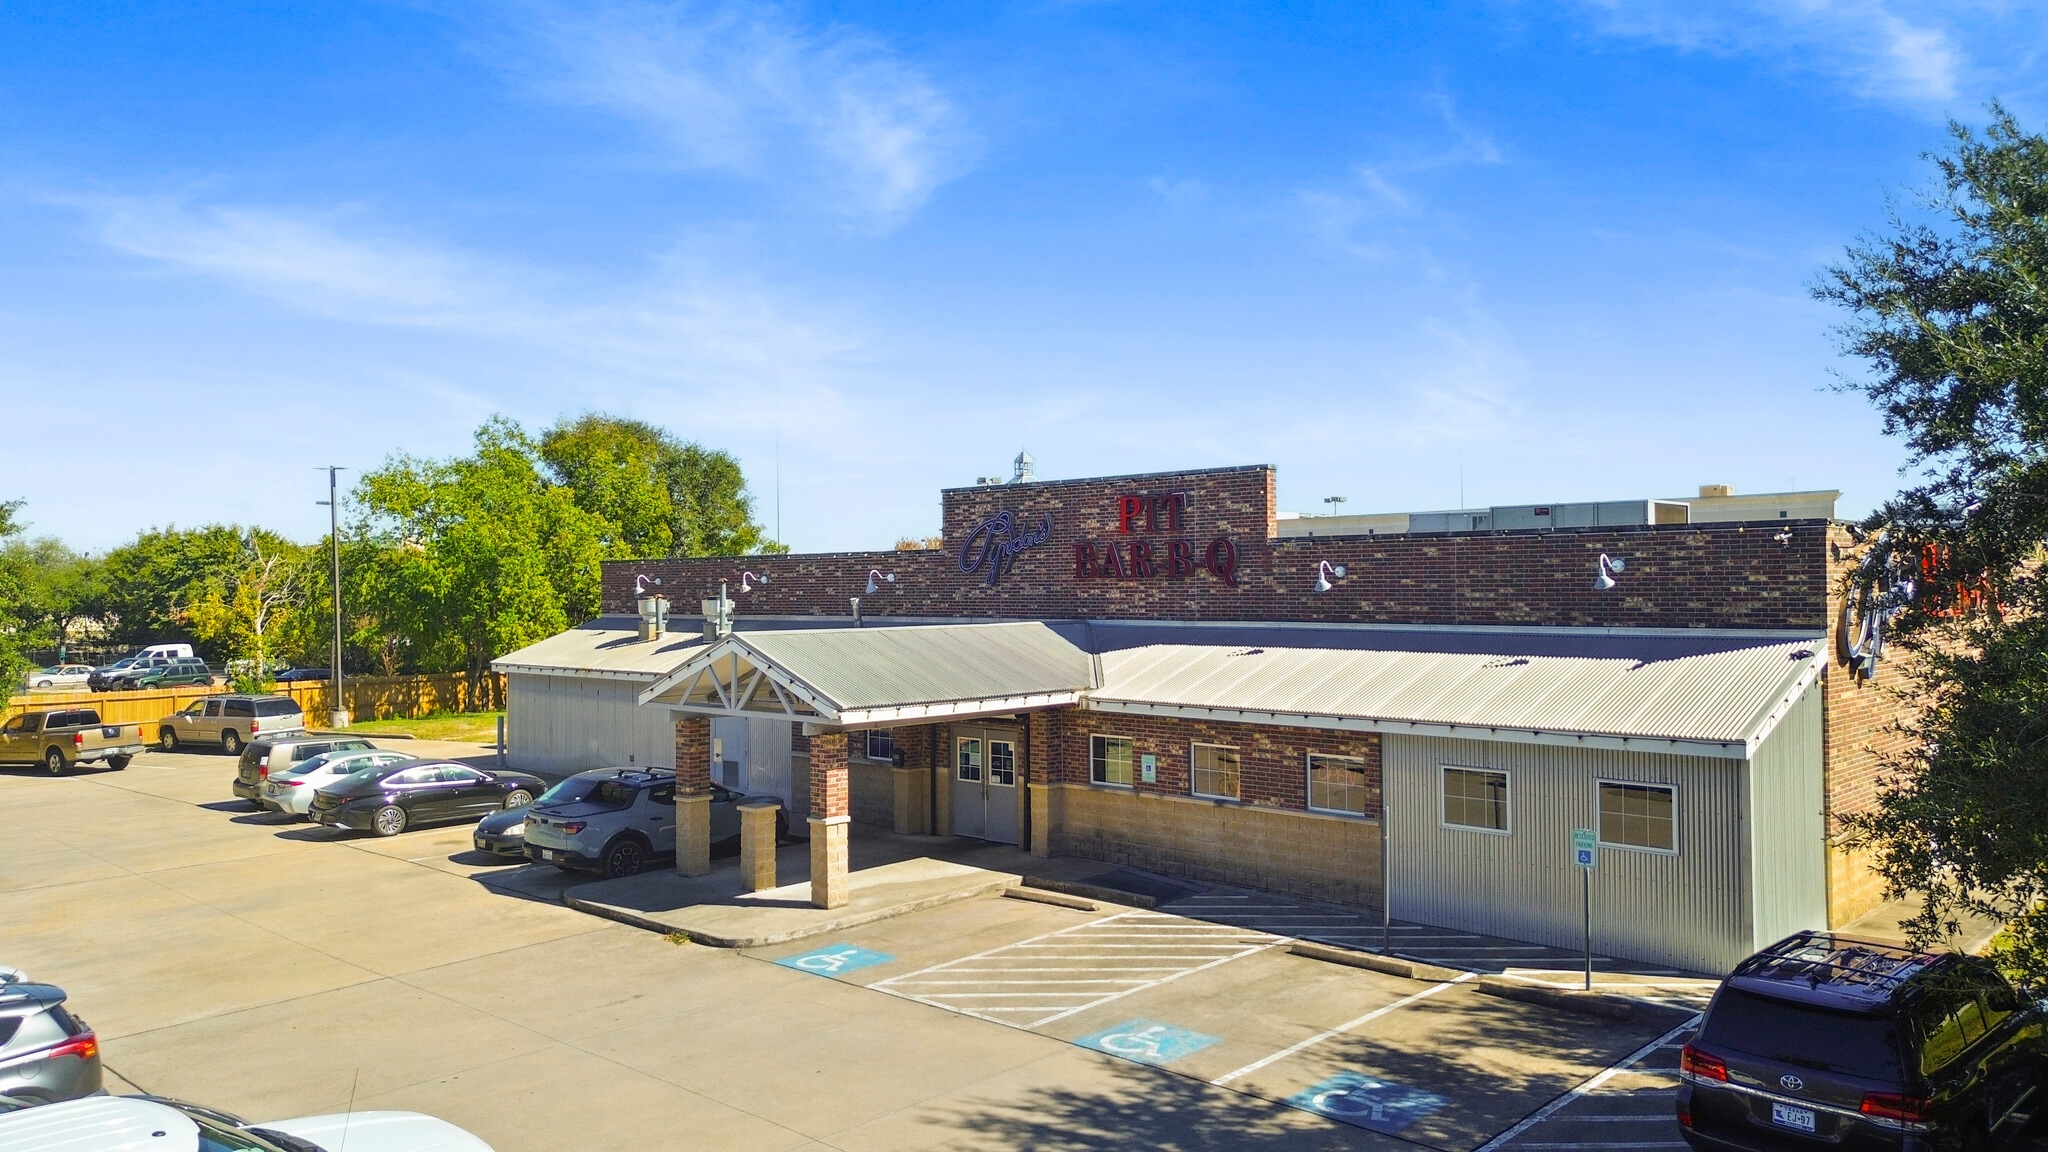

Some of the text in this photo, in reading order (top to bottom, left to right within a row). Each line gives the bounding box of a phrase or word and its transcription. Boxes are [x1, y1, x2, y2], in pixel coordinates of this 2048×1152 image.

[1118, 492, 1188, 535] PIT
[1574, 832, 1595, 841] RESERVED
[1575, 841, 1593, 849] PARKING
[1784, 1106, 1804, 1114] TEXAS
